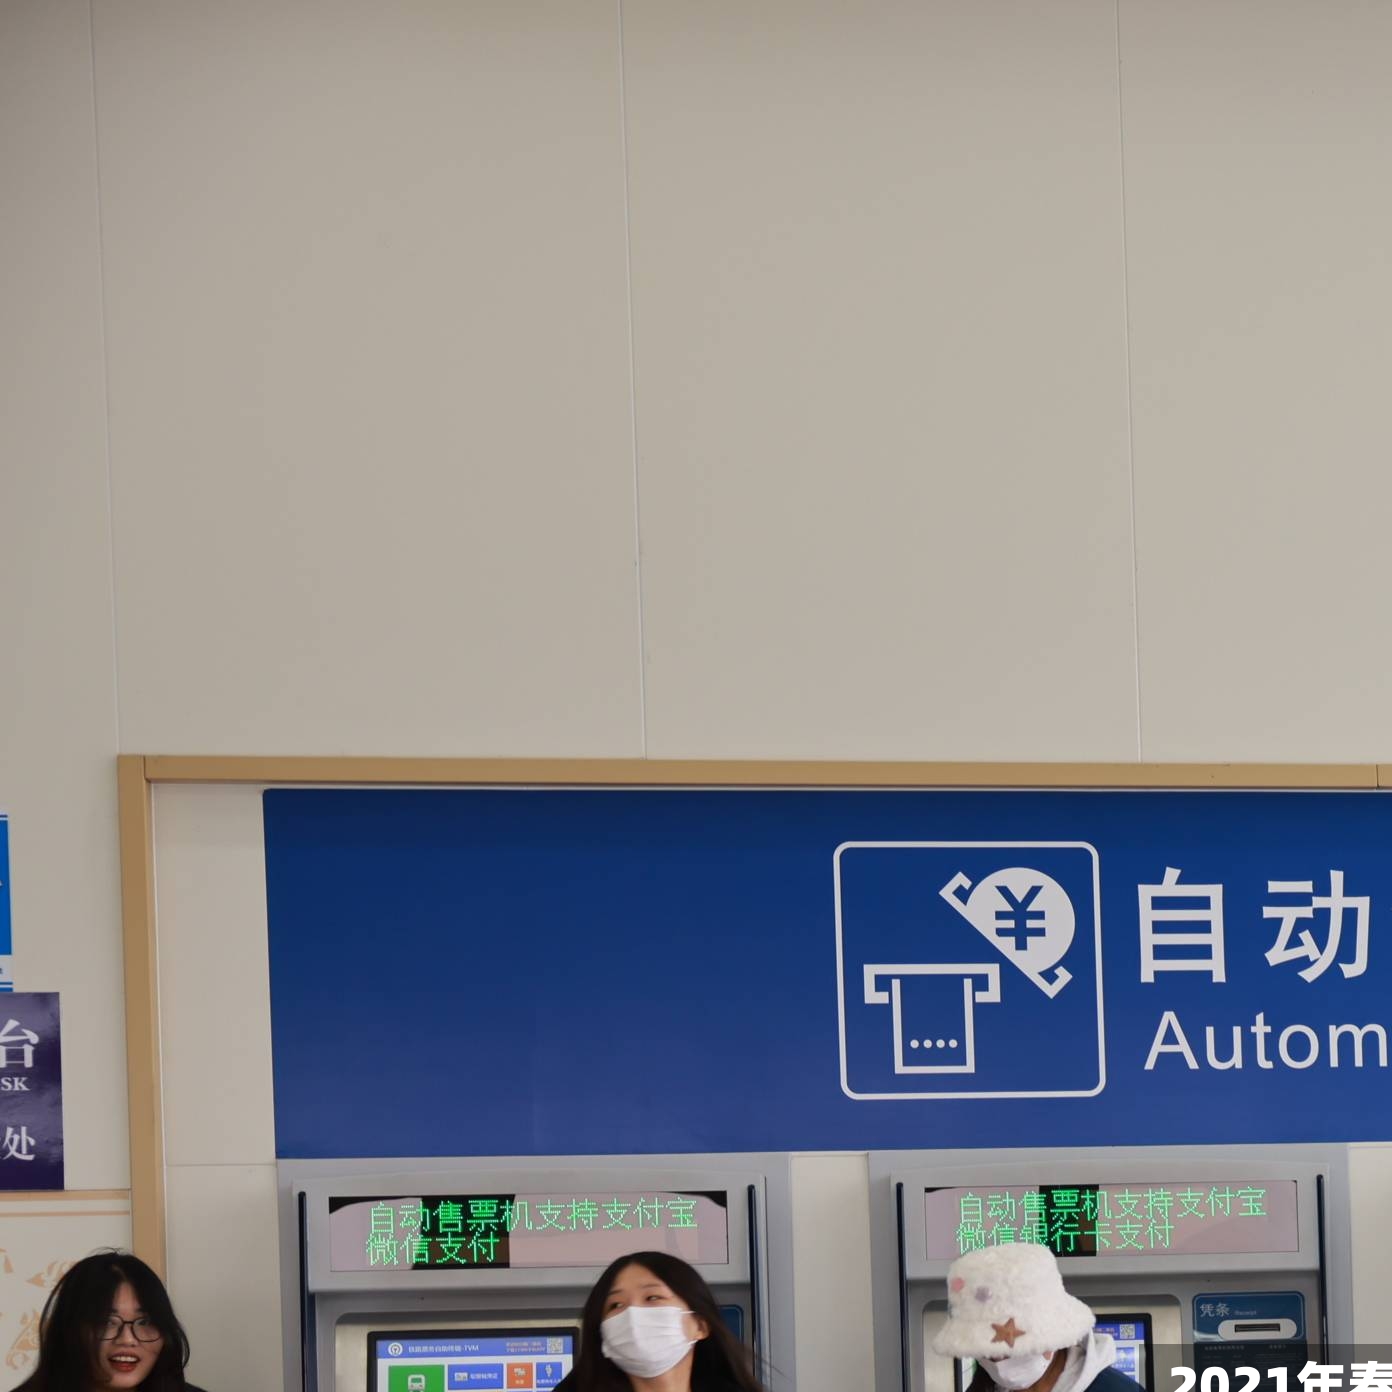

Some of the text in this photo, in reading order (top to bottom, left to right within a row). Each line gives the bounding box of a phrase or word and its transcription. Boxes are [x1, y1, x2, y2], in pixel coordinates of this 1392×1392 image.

[368, 1197, 699, 1235] 自动售票机支持支付宝
[958, 1186, 1268, 1224] 自动售票机支持支付宝
[366, 1231, 500, 1266] 微信支付
[956, 1220, 1175, 1255] 微信银行卡支付
[1200, 1302, 1230, 1318] 凭条
